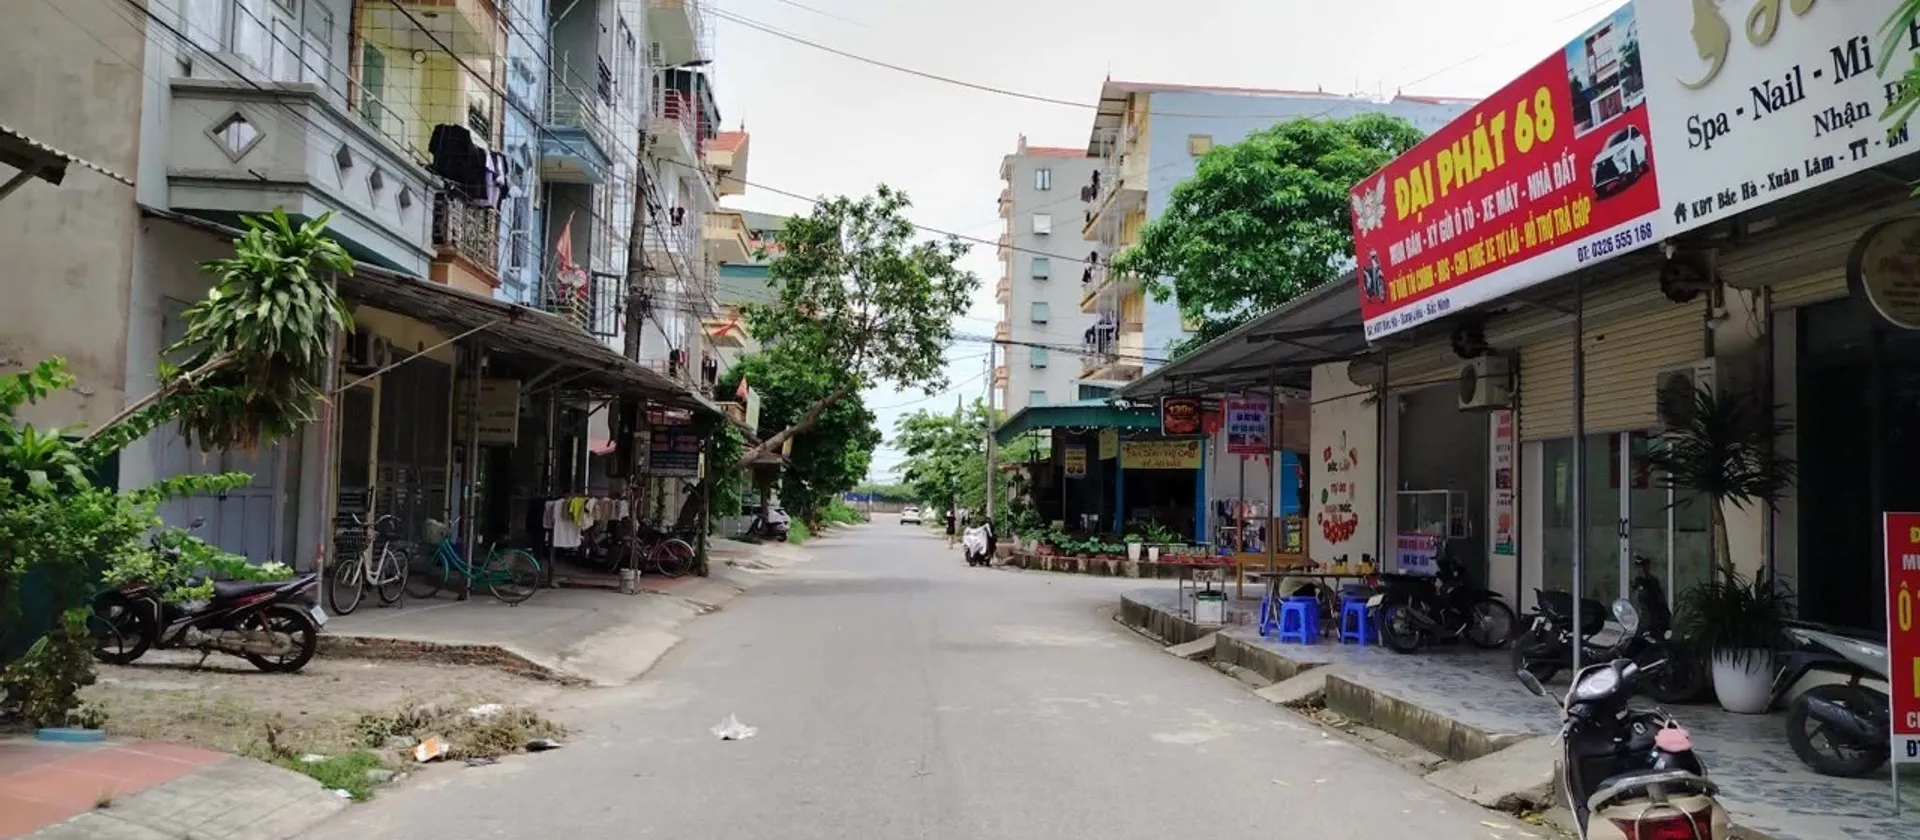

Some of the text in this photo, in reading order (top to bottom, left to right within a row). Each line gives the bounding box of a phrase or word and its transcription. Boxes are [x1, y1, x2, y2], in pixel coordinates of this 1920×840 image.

[1687, 35, 1874, 150] Spa Nail Mi
[1812, 100, 1872, 137] Nhận
[1394, 86, 1555, 223] ĐẠI PHÁT 68
[1454, 207, 1462, 236] Ô
[1463, 200, 1475, 231] TÔ
[1481, 194, 1495, 223] XE
[1495, 180, 1519, 216] MÁY
[1527, 161, 1553, 201] NHÀ
[1552, 147, 1576, 190] ĐẤT
[1691, 196, 1713, 220] KĐT
[1718, 187, 1737, 210] Bắc
[1741, 180, 1758, 201] Hà
[1767, 167, 1800, 192] Xuân
[1804, 154, 1835, 178] Lâm
[1849, 137, 1869, 162] TT
[1591, 237, 1614, 258] 0326
[1615, 229, 1632, 249] 555
[1634, 222, 1653, 242] 168
